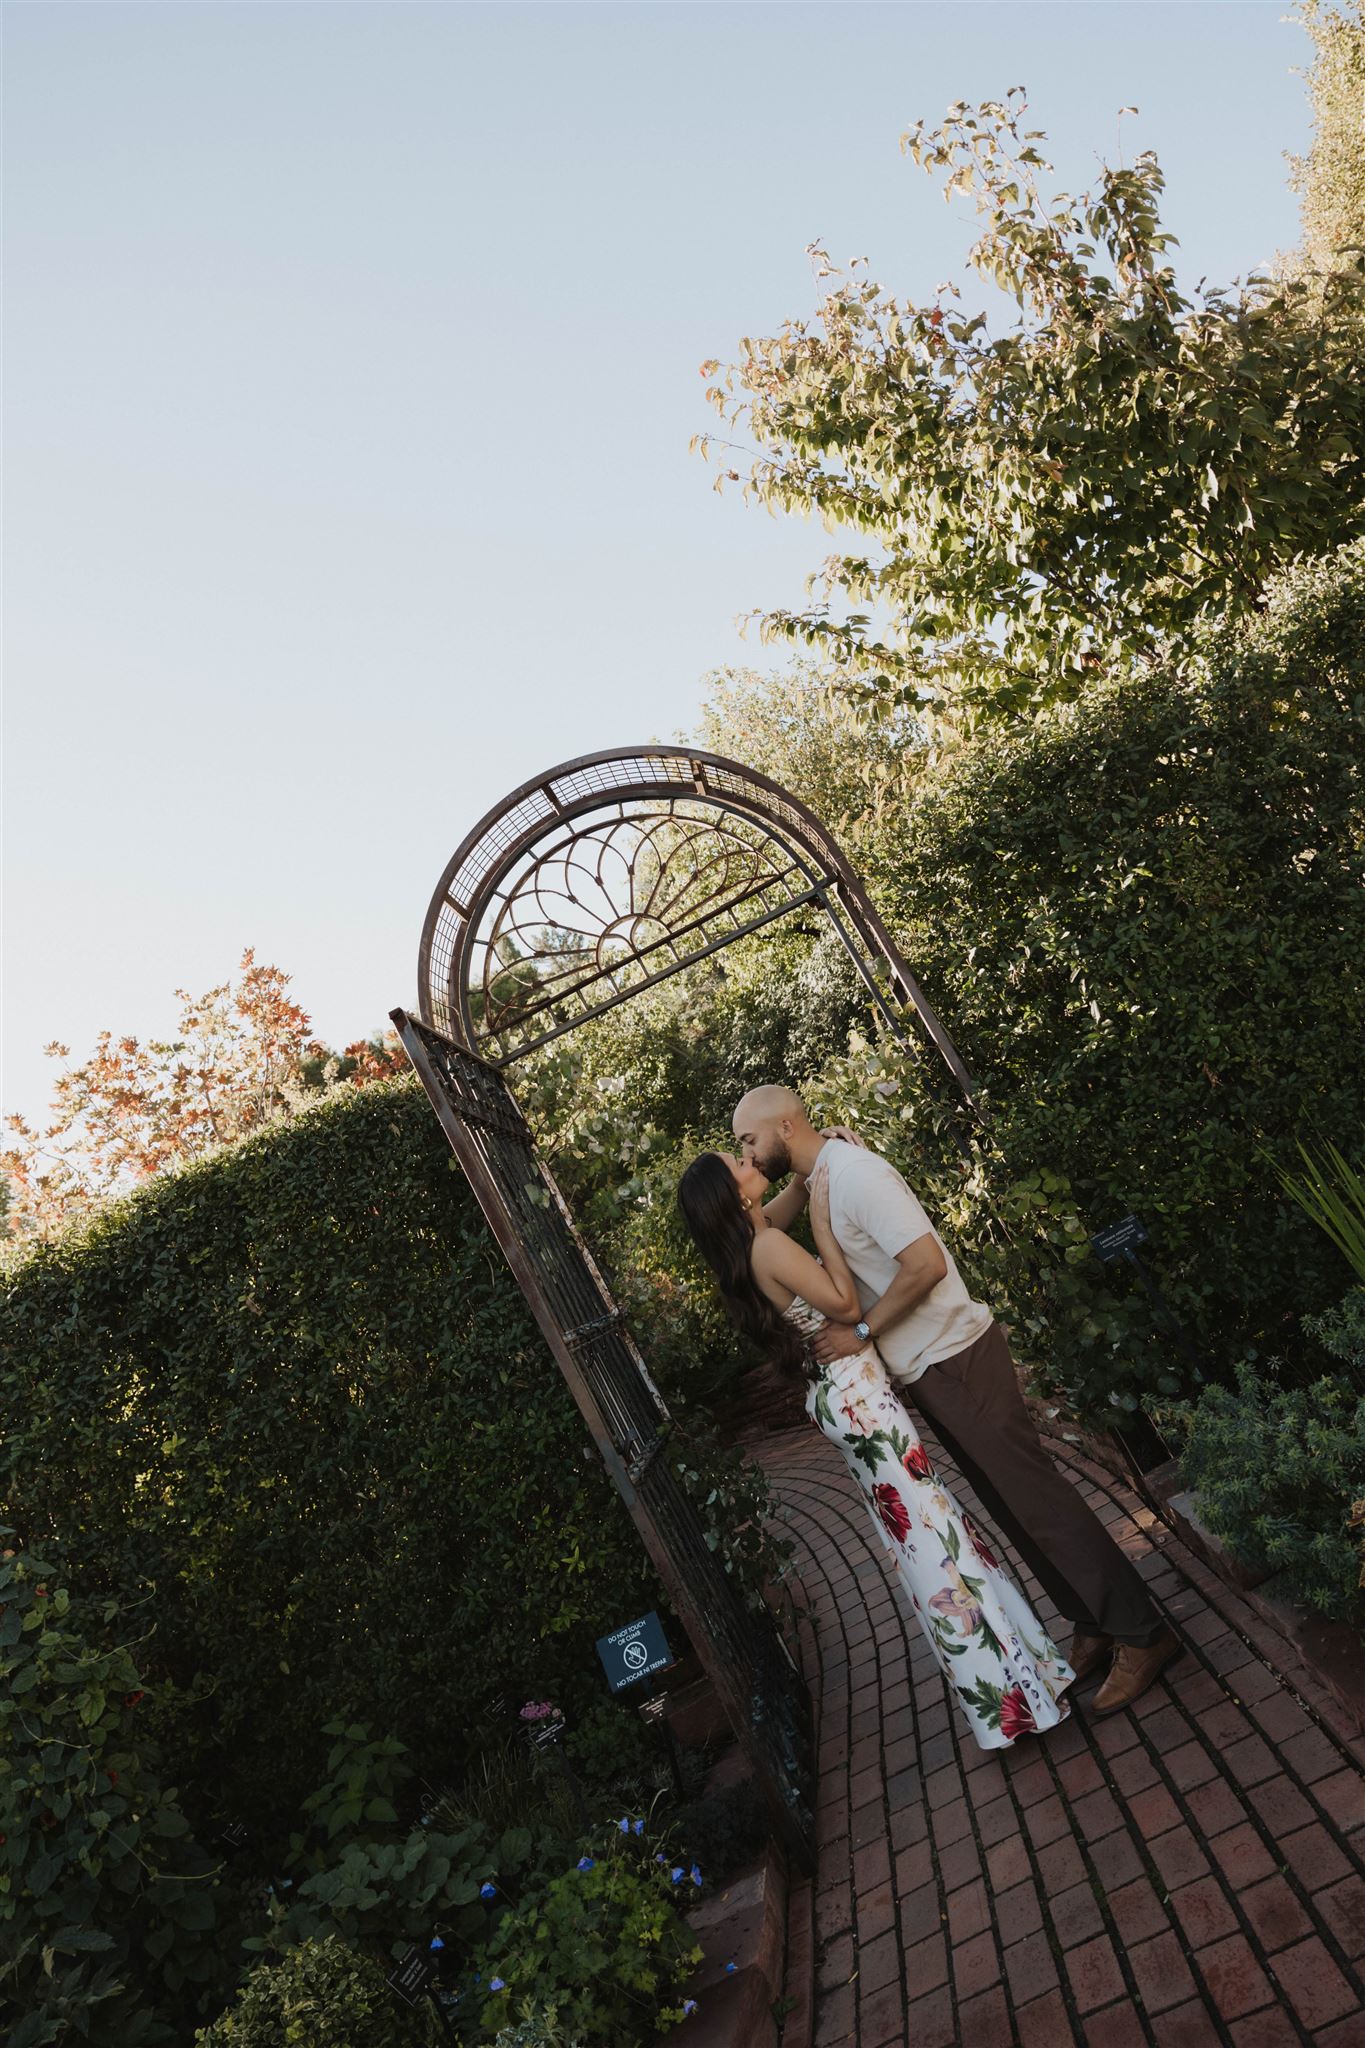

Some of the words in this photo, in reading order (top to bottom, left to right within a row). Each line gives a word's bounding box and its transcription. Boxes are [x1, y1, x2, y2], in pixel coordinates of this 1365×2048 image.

[608, 1635, 616, 1644] DO
[617, 1629, 628, 1639] NOT
[628, 1620, 646, 1631] TOUCH
[617, 1638, 626, 1646] OR
[626, 1630, 641, 1641] CLIMB
[617, 1679, 626, 1688] NO
[626, 1670, 643, 1681] TOCAR
[643, 1666, 650, 1674] NI
[649, 1657, 667, 1670] TREPAR
